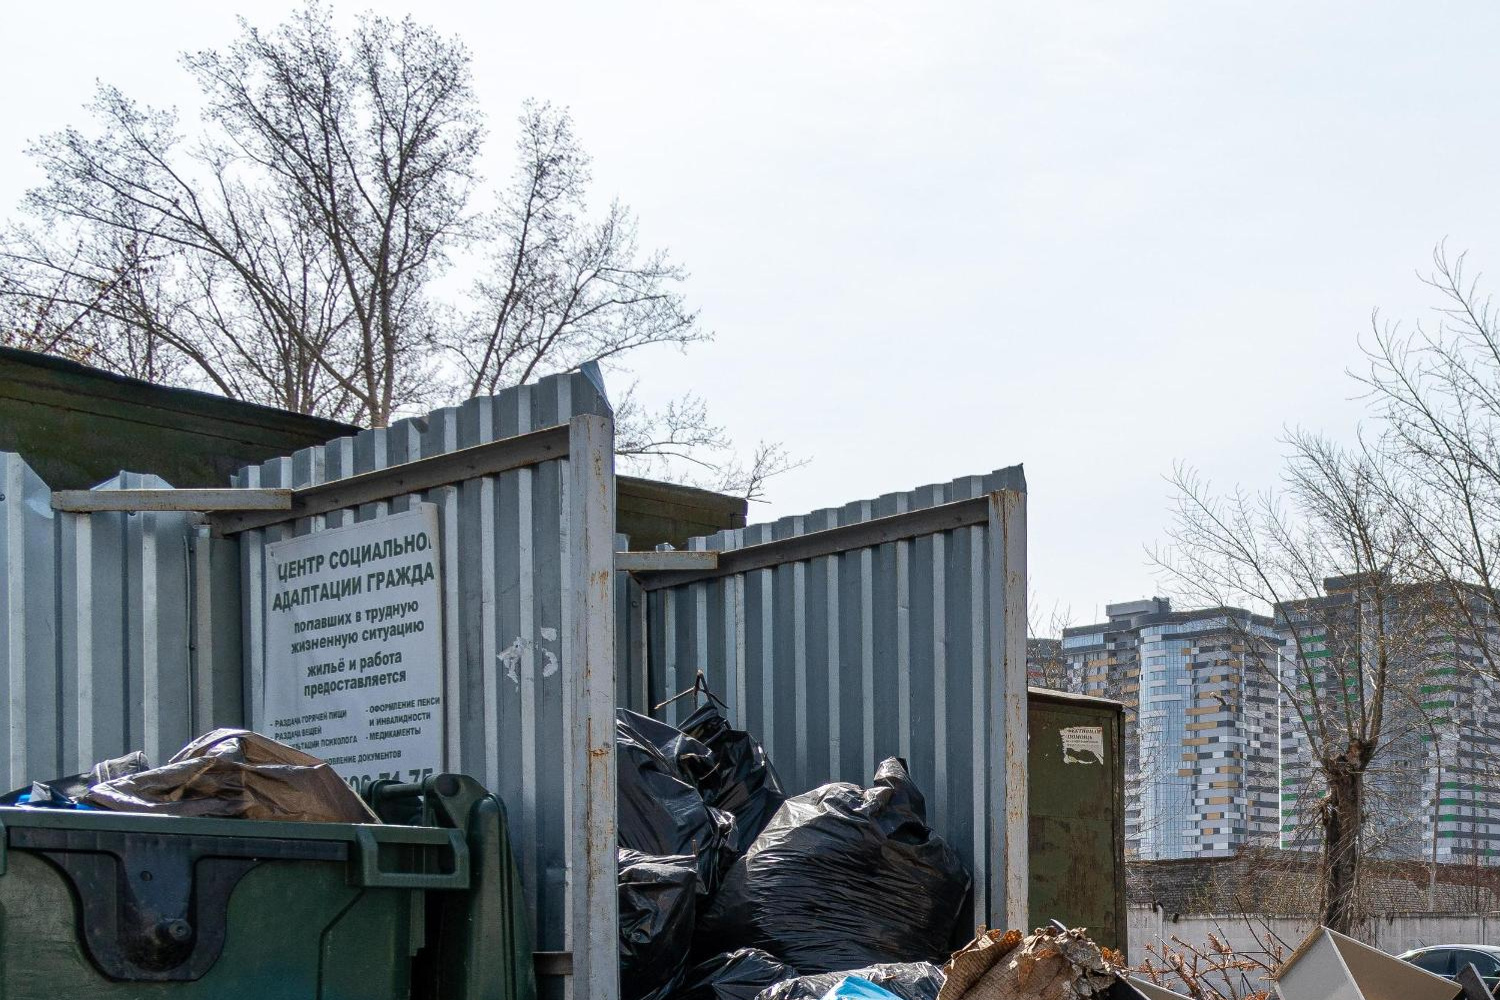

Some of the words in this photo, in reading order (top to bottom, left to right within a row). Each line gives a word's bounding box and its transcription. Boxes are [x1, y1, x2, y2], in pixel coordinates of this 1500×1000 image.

[278, 555, 324, 583] ЦЕНТР
[272, 576, 362, 612] АДАПТАЦИИ
[294, 613, 351, 634] попавших
[356, 611, 362, 622] в
[366, 600, 418, 623] трудную
[291, 630, 358, 654] жизненную
[362, 620, 424, 641] ситуацию
[307, 658, 344, 677] жильё
[349, 660, 356, 670] и
[360, 651, 402, 673] работа
[304, 670, 406, 698] предоставляется
[370, 700, 415, 713] ОФОРМЛЕНИЕ
[302, 712, 327, 724] ГОРЯЧЕЙ
[329, 710, 347, 720] ПИЩИ
[376, 712, 431, 726] ИНВАЛИДНОСТИ
[302, 726, 322, 736] ВЕЩЕЙ
[369, 727, 421, 740] МЕДИКАМЕНТЫ
[320, 736, 358, 748] ПСИХОЛОГА
[358, 750, 402, 764] ДОКУМЕНТОВ
